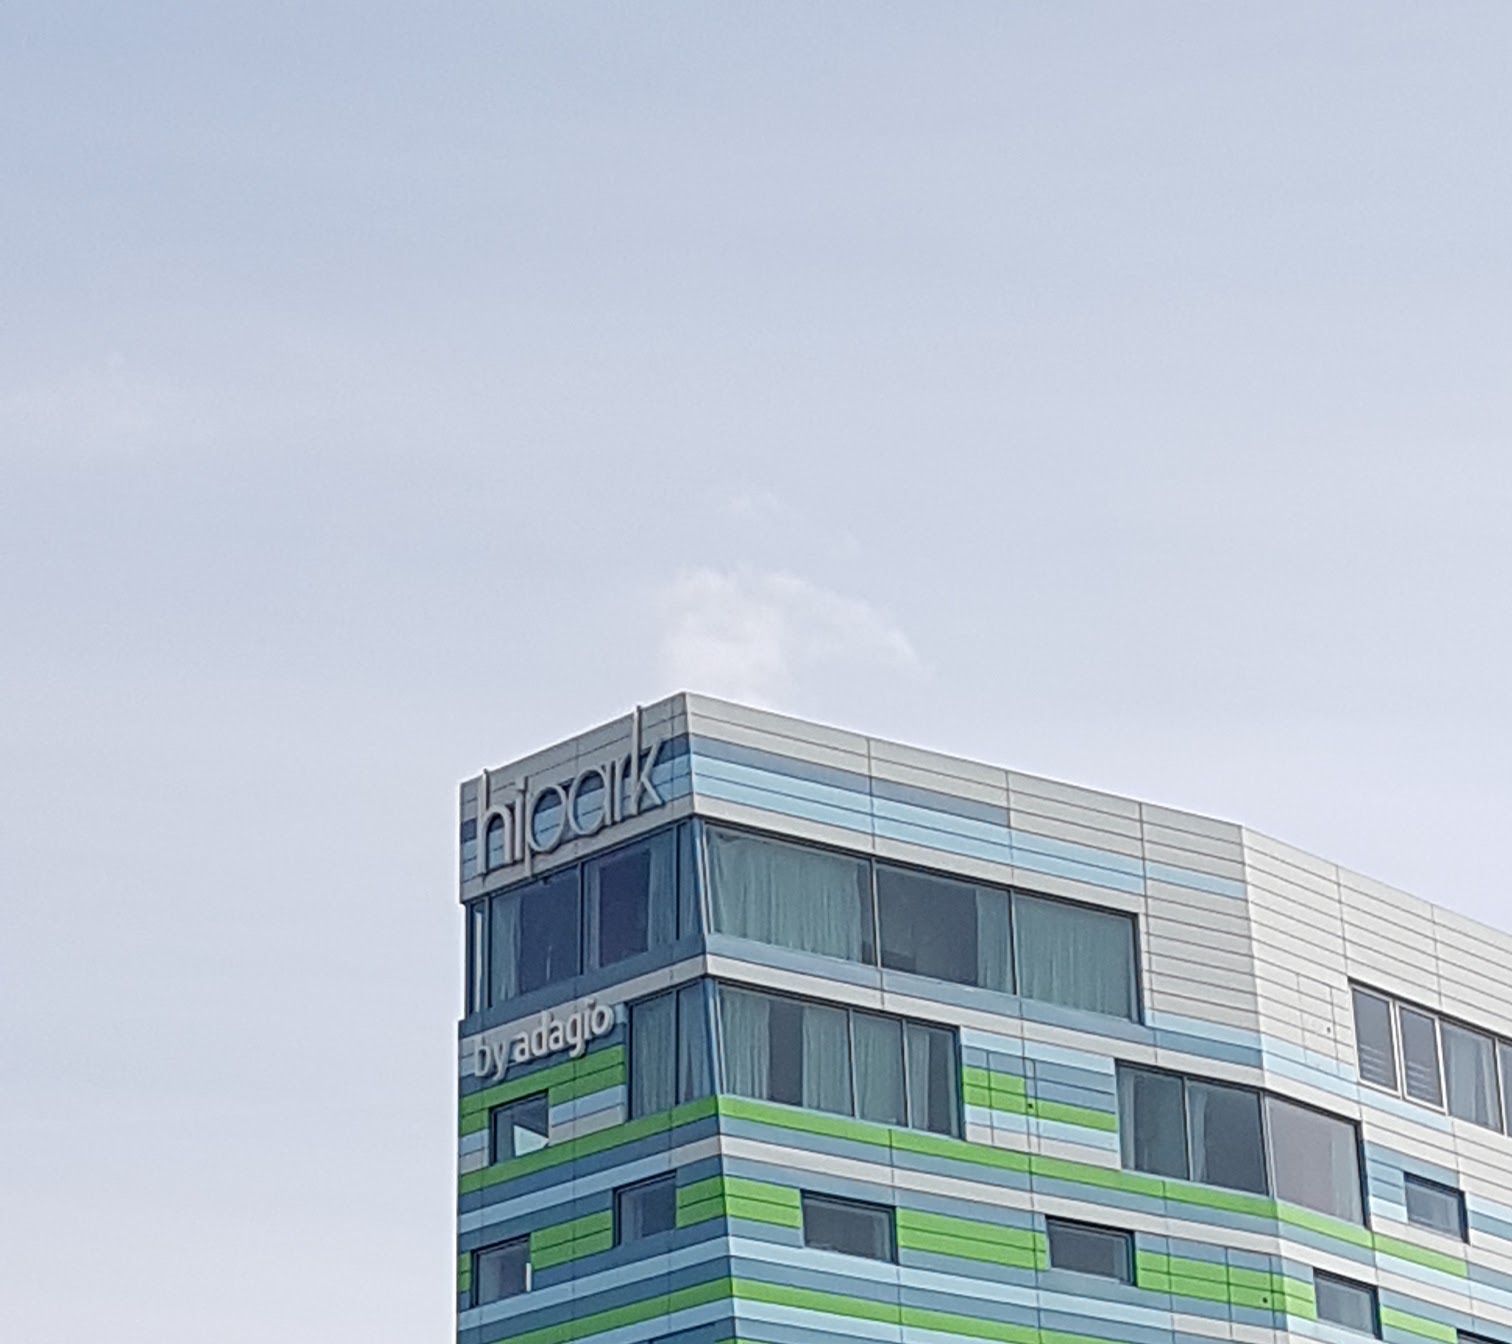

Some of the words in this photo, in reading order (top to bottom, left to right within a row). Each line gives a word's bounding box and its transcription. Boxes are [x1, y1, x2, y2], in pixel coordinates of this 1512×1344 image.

[478, 706, 664, 876] hipark
[475, 1036, 511, 1080] by
[513, 998, 615, 1058] adagio
